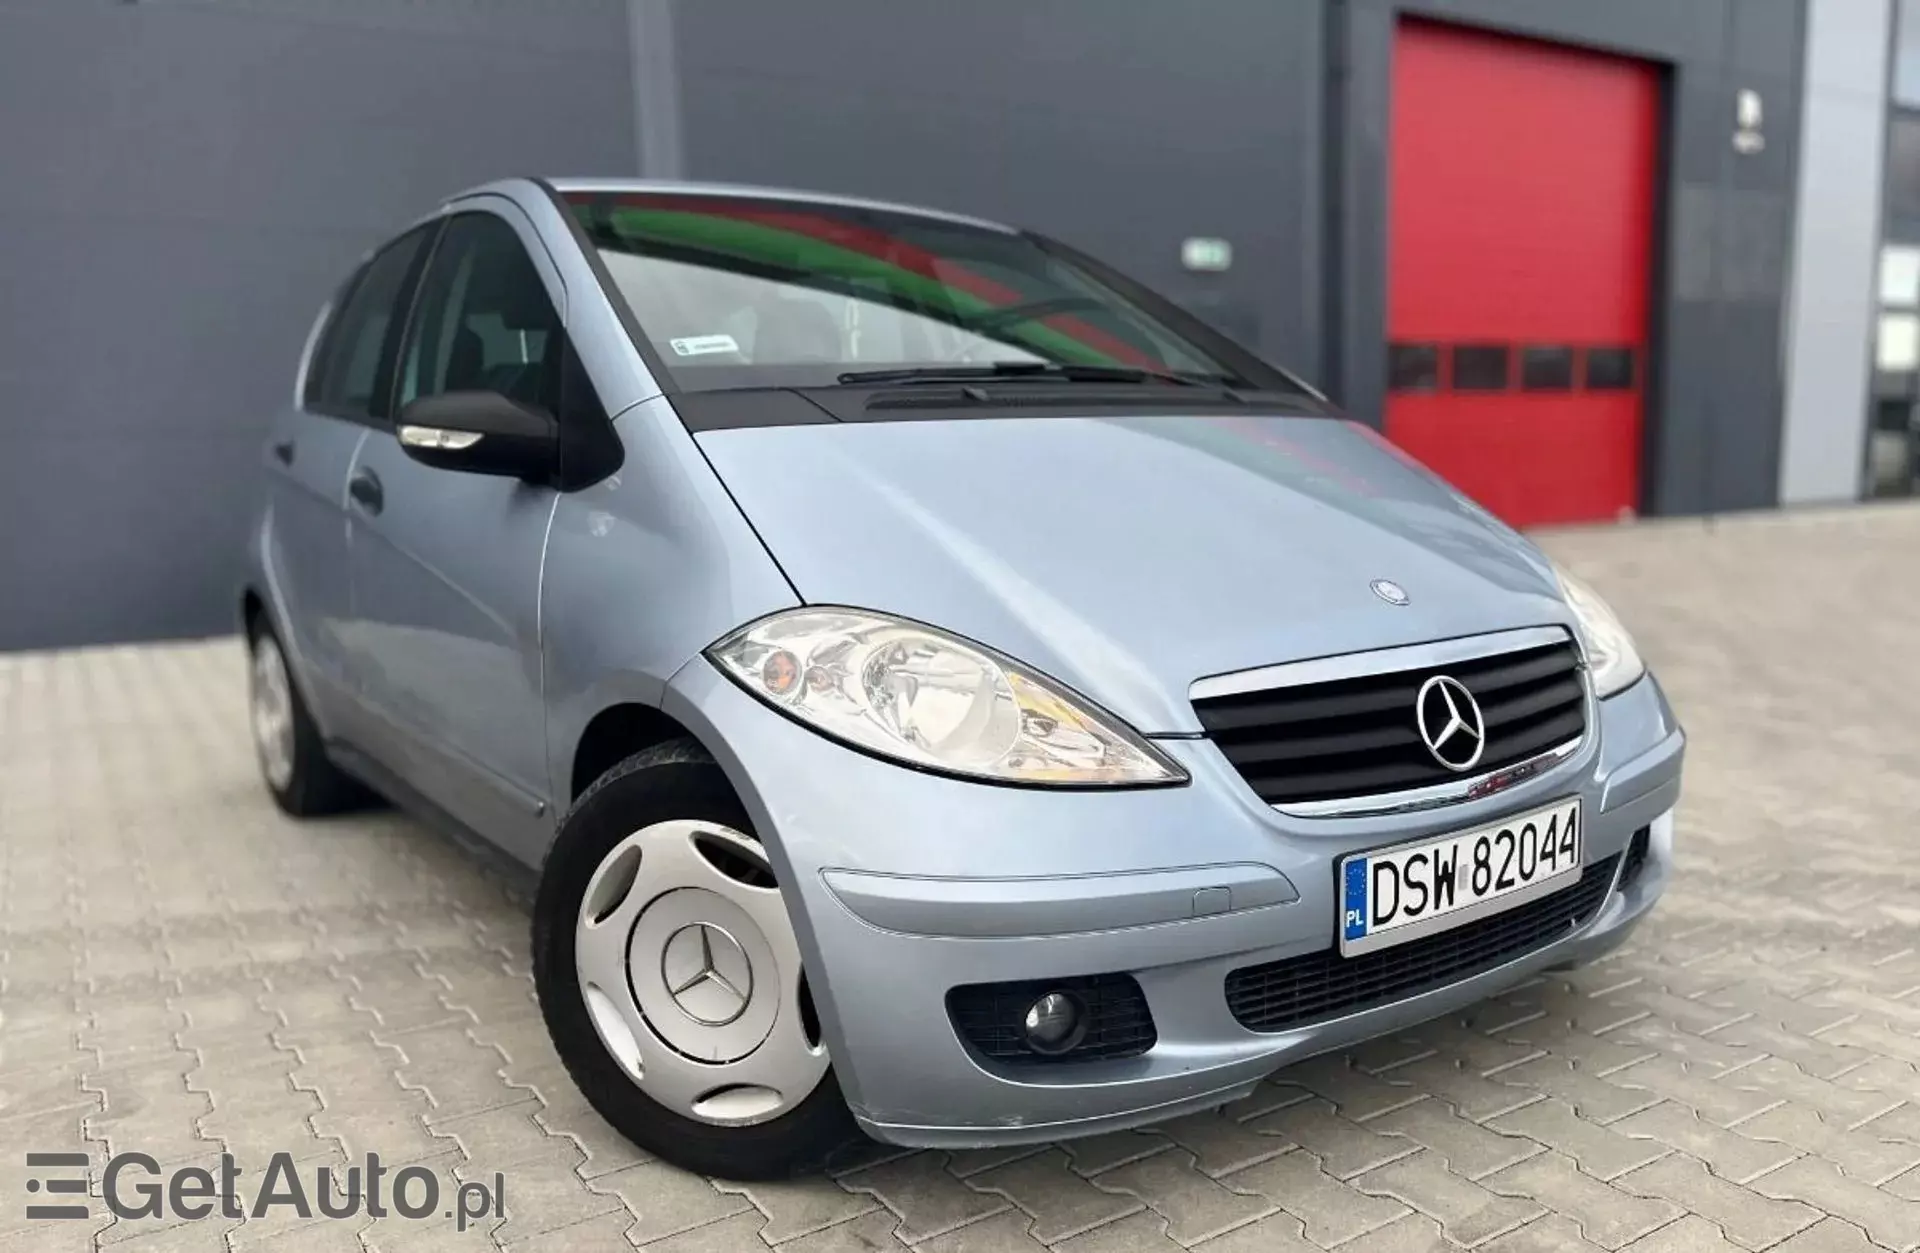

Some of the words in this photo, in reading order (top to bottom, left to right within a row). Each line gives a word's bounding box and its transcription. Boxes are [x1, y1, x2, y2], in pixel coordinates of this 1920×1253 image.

[1372, 845, 1458, 926] DSW
[1472, 807, 1577, 896] 82044
[1345, 909, 1364, 928] PL
